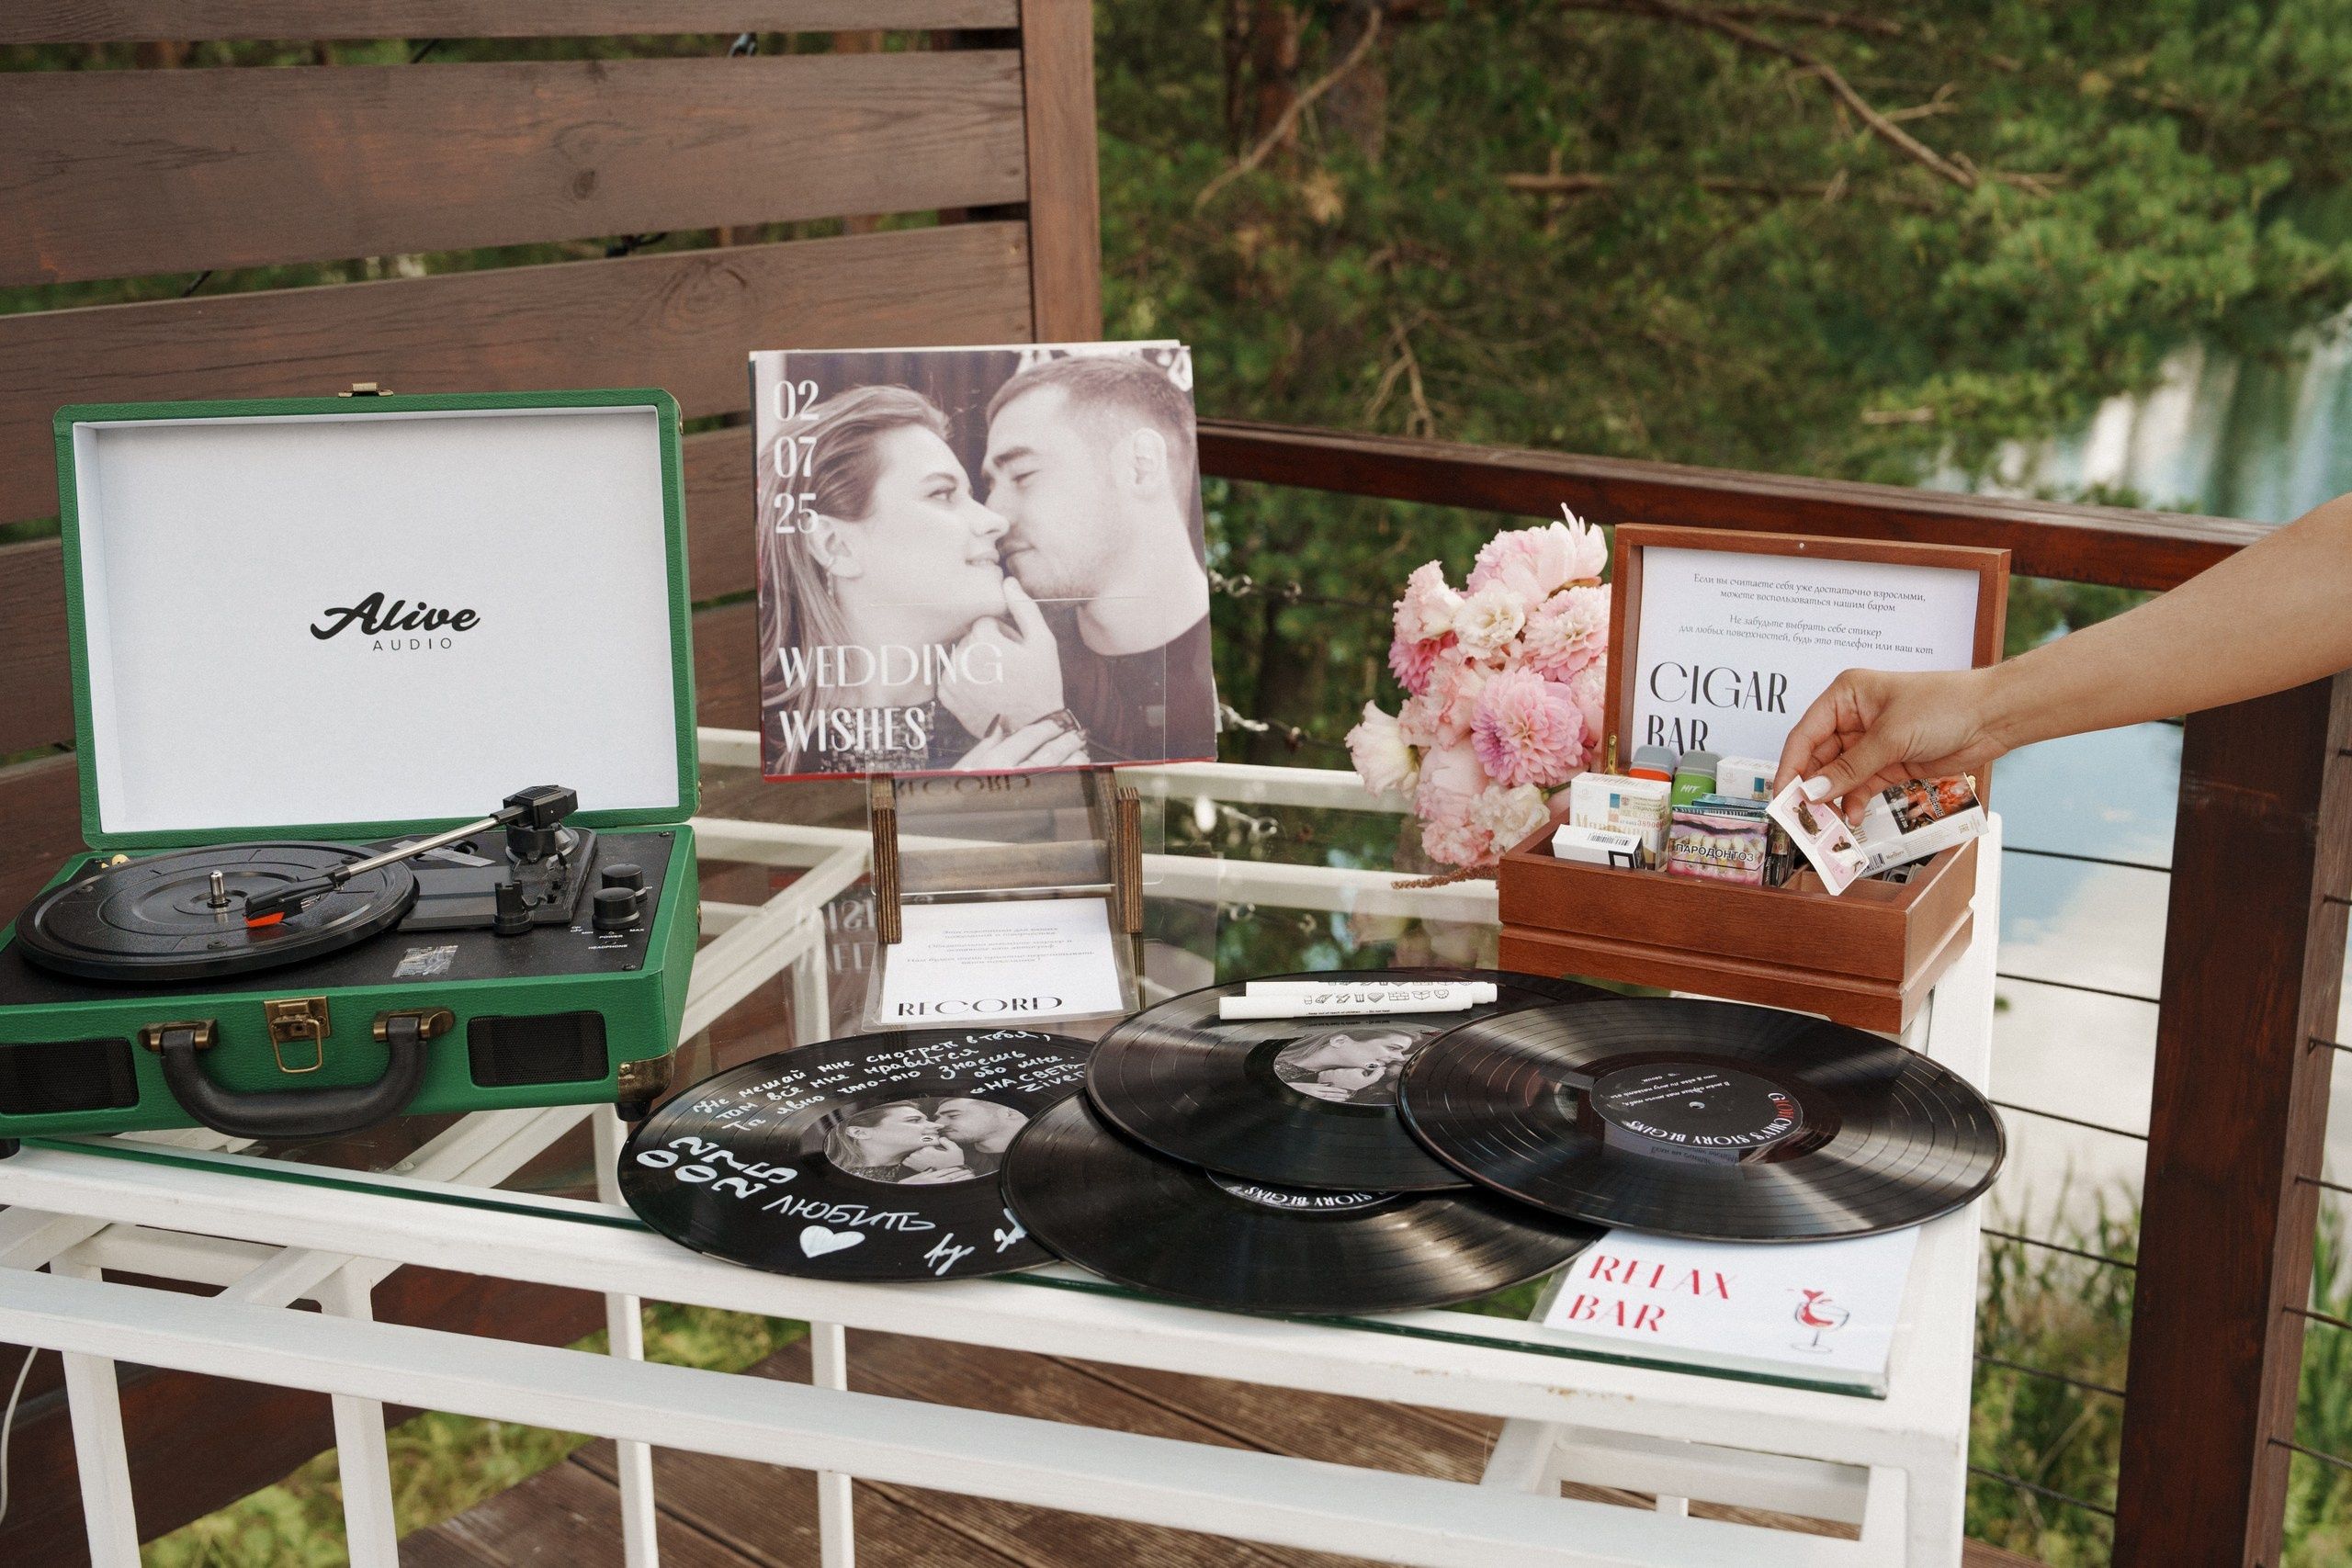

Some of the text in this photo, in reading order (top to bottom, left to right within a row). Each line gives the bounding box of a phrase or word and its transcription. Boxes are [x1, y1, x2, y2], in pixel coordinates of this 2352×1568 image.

[773, 380, 820, 421] 02
[774, 437, 817, 479] 07
[774, 492, 819, 535] 25
[1694, 573, 1713, 583] Если
[1730, 578, 1774, 588] считаете
[1776, 581, 1794, 591] себя
[1796, 584, 1813, 593] уже
[1815, 586, 1871, 596] достаточно
[1874, 591, 1926, 602] взрослыми,
[1721, 591, 1895, 613] можете воспользоваться нашим баром
[311, 592, 481, 640] Alive
[1730, 615, 1882, 639] Не забудьте выбрать себе стикер
[372, 637, 452, 651] AUDIO
[1695, 626, 1724, 636] любых
[1792, 632, 1812, 645] будь
[1815, 637, 1832, 646] это
[1834, 637, 1873, 651] телефон
[1875, 642, 1893, 651] или
[1894, 645, 1913, 653] ваш
[1916, 647, 1933, 655] кот
[777, 642, 1004, 688] WEDDING
[1649, 661, 1788, 715] CIGAR
[778, 706, 928, 753] WISHES
[1647, 715, 1709, 756] BAR
[1679, 784, 1702, 794] HIT
[1675, 843, 1754, 863] ПАРОДОНТОЗ
[898, 996, 1063, 1017] RECORD
[1016, 1071, 1086, 1093] Ziver
[1627, 1120, 1687, 1143] BEGINS
[1692, 1134, 1750, 1146] STORY
[1244, 1186, 1373, 1207] STORY BEGINS
[762, 1195, 936, 1231] ЛЮБИТЬ
[1589, 1255, 1738, 1301] RELAX
[1567, 1294, 1666, 1333] BAR
